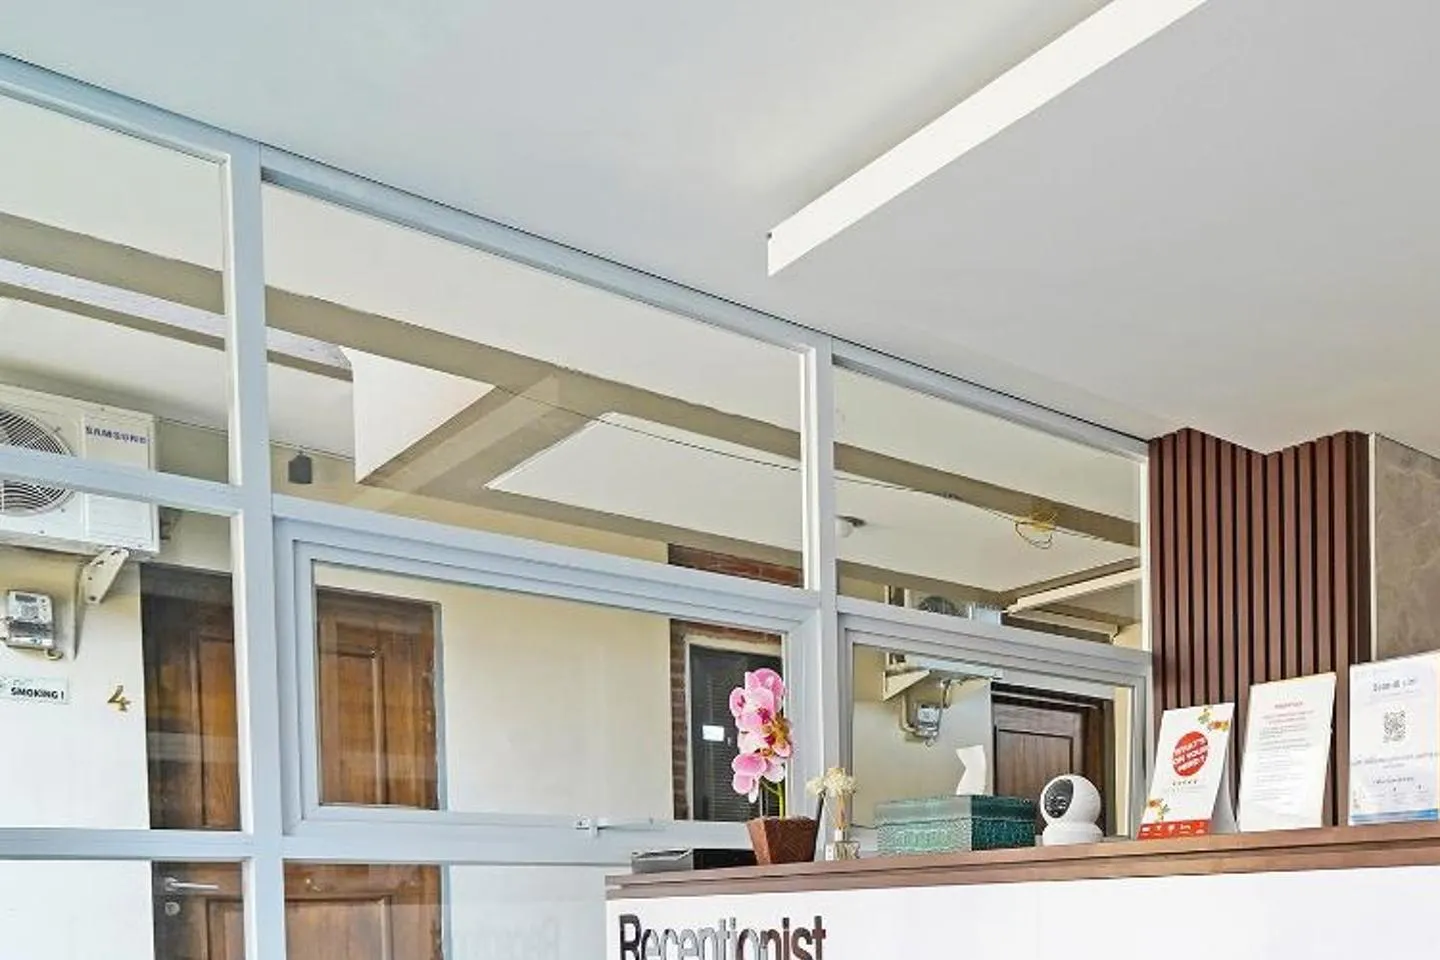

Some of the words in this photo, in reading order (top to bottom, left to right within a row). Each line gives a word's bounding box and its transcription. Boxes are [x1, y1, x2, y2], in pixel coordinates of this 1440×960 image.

[85, 425, 147, 444] SAMSUNG
[11, 686, 58, 699] SMOKING
[107, 684, 131, 711] 4
